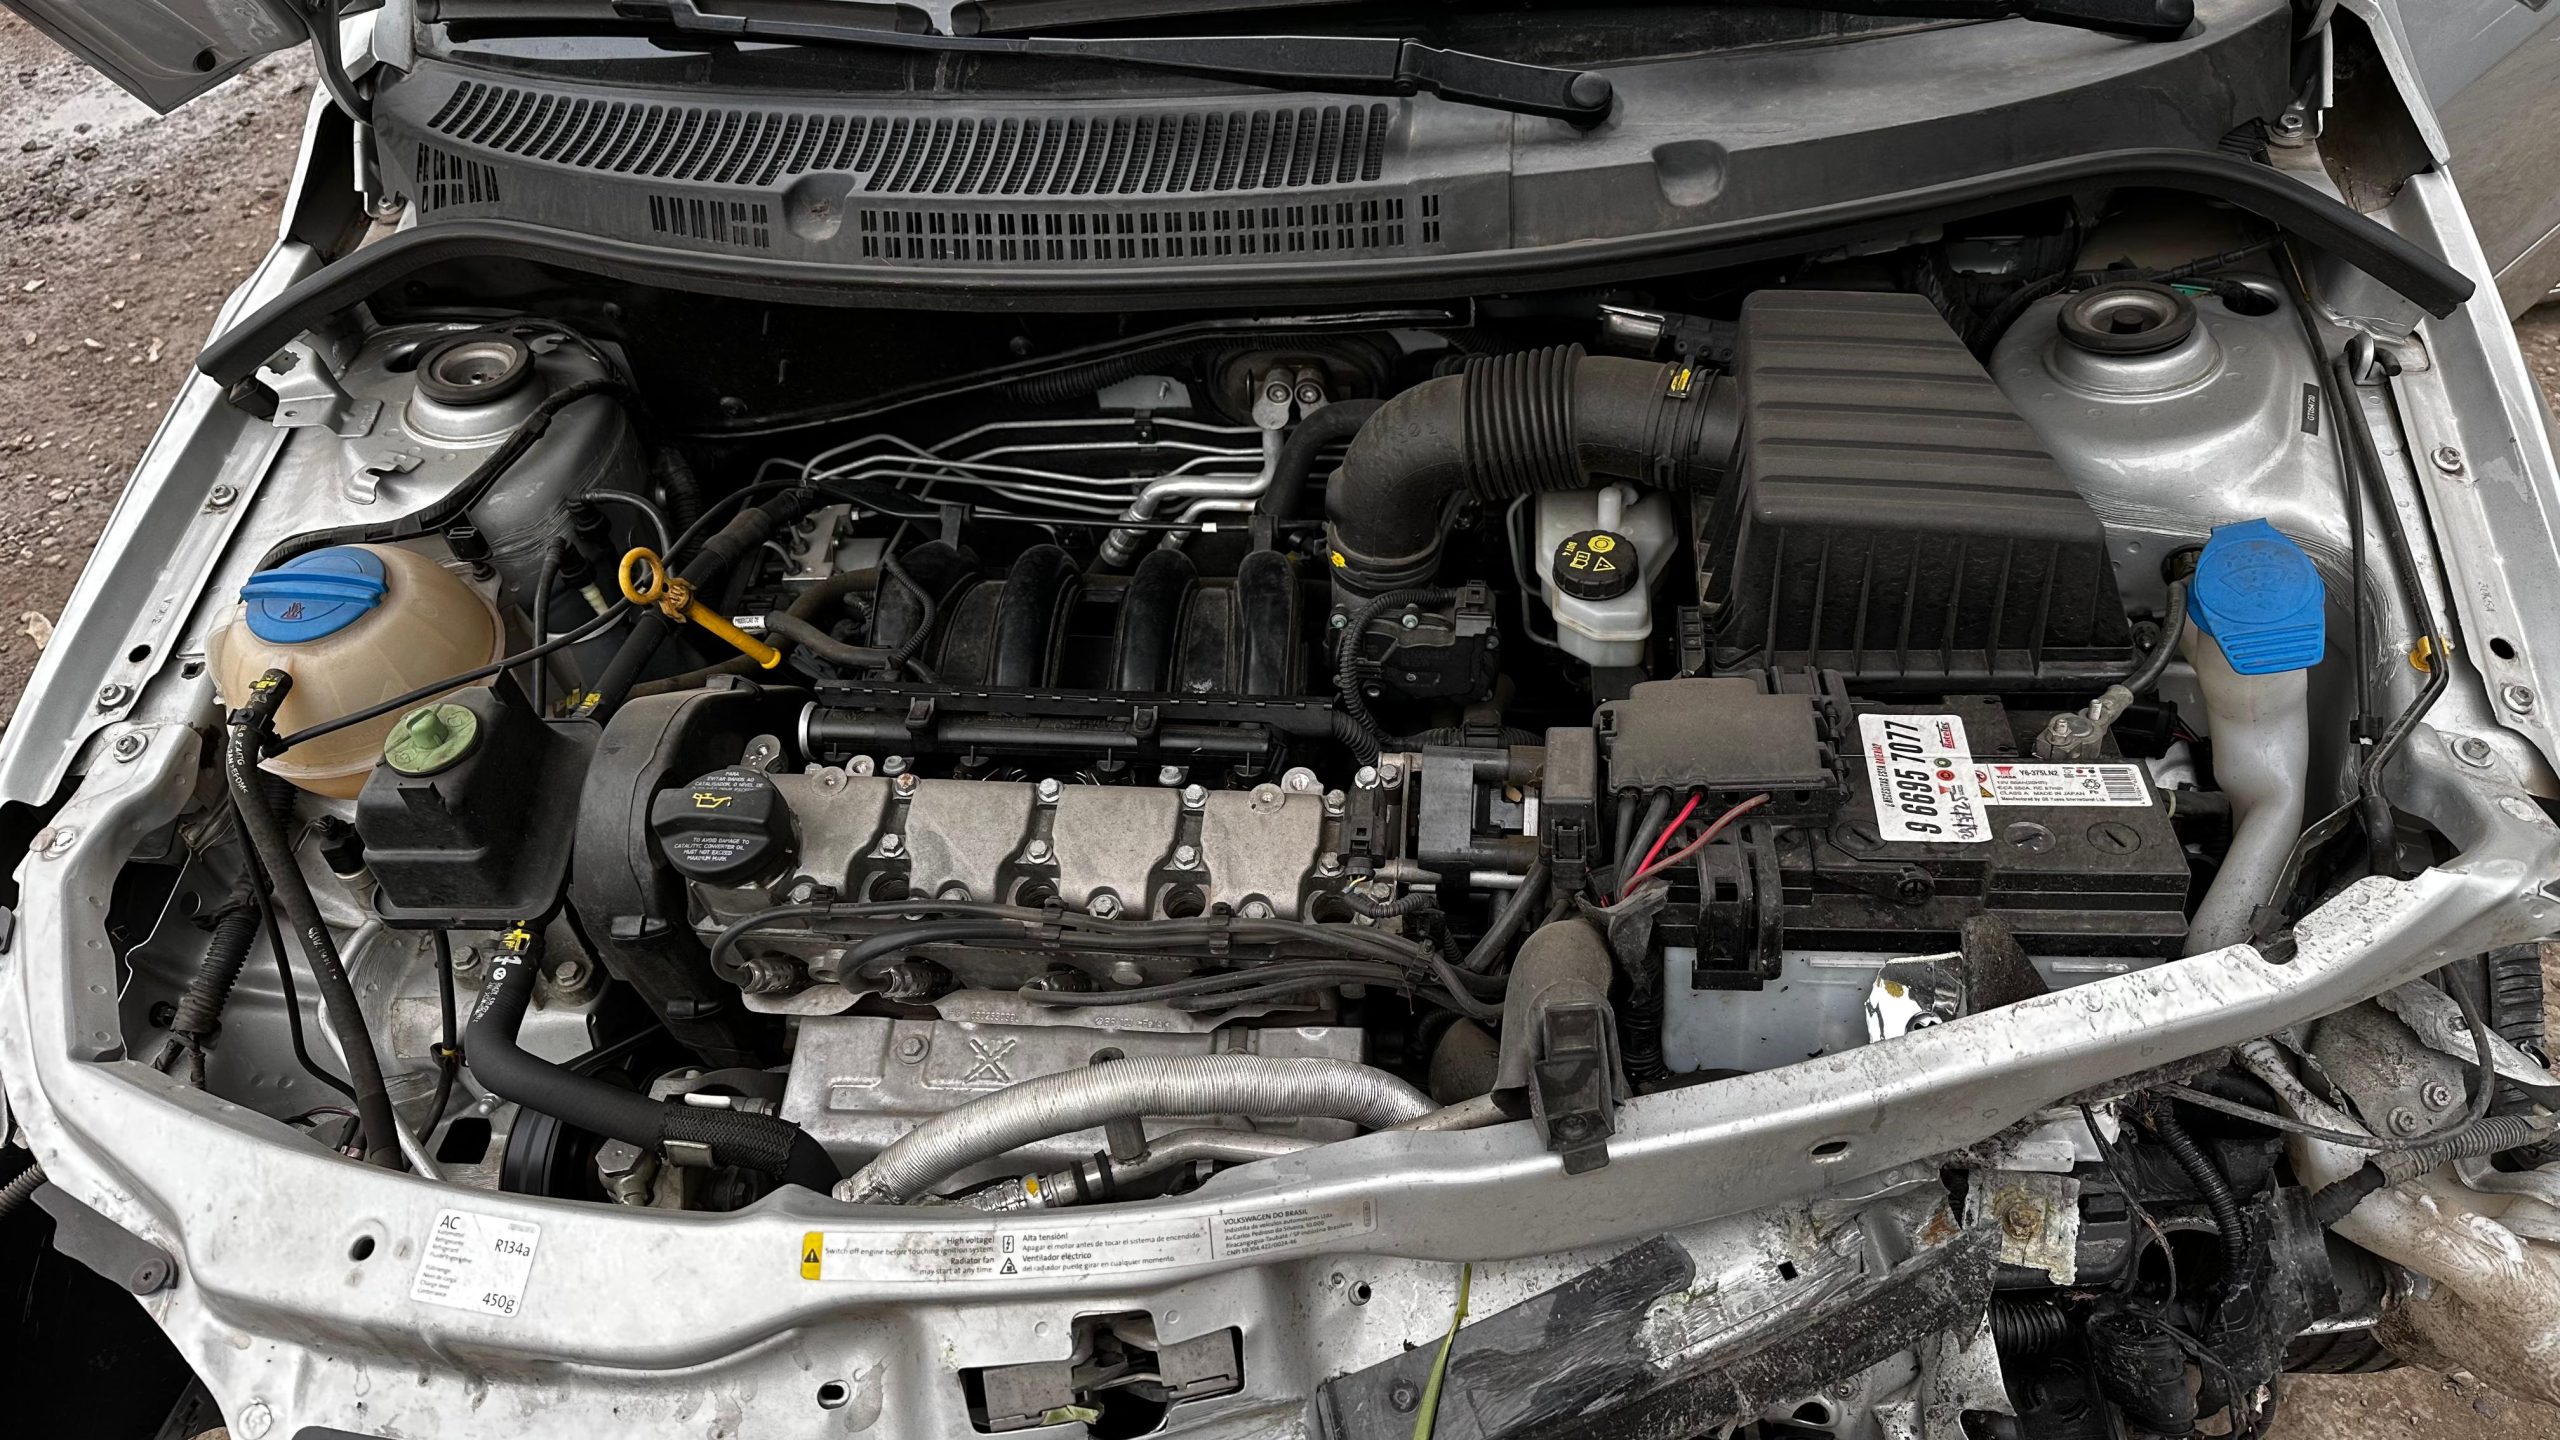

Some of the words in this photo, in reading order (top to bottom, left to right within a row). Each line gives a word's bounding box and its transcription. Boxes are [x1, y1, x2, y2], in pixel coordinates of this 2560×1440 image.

[1884, 720, 1925, 763] 7077
[1876, 766, 1888, 777] ESTA
[1894, 768, 1938, 816] 6695
[1905, 821, 1942, 834] 9
[440, 1215, 461, 1230] AC
[1223, 1213, 1272, 1225] VOLKSWAGEN
[1272, 1211, 1284, 1219] DO
[1285, 1208, 1308, 1217] BRASIL
[1283, 1215, 1320, 1225] automotores
[1023, 1234, 1038, 1242] Alta
[1251, 1229, 1275, 1237] Pedroso
[947, 1237, 965, 1246] High
[966, 1236, 995, 1246] voltage!
[1022, 1244, 1046, 1252] Apagar
[1130, 1237, 1156, 1245] sistema
[495, 1239, 531, 1257] R134a
[825, 1247, 848, 1255] Switch
[850, 1247, 860, 1255] off
[860, 1248, 883, 1257] engine
[885, 1247, 907, 1257] before
[908, 1247, 940, 1257] touching
[941, 1246, 968, 1256] ignition
[950, 1257, 981, 1265] Radiator
[982, 1256, 995, 1264] fan
[1023, 1253, 1060, 1263] Ventilador
[1061, 1251, 1092, 1260] eléctrico
[919, 1268, 935, 1276] may
[963, 1267, 975, 1275] any
[1022, 1264, 1033, 1272] del
[1033, 1264, 1061, 1272] radiador
[1062, 1263, 1083, 1272] puede
[1084, 1262, 1100, 1270] girar
[1110, 1259, 1141, 1268] cualquier
[482, 1293, 515, 1314] 450g
